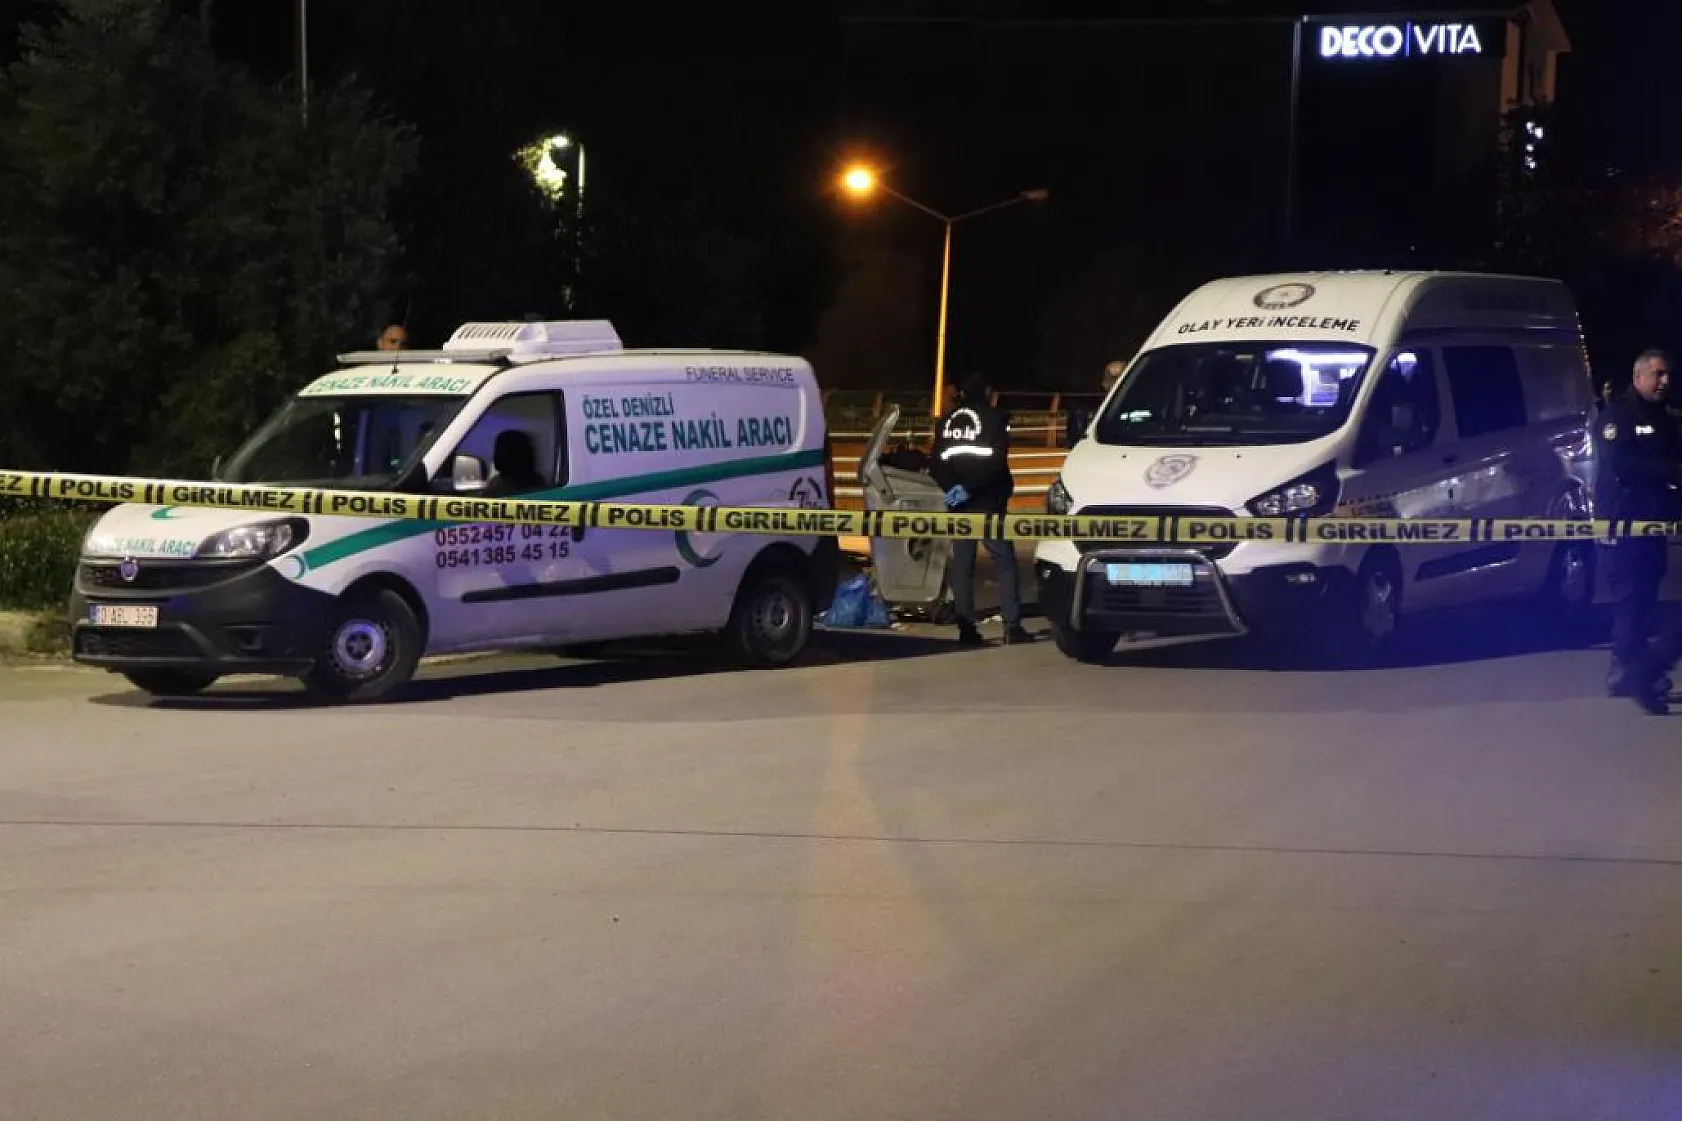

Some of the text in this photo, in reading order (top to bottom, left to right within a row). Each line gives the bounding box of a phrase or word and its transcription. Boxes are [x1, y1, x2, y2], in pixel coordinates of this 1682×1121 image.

[1321, 24, 1481, 56] DECO VITA
[1178, 319, 1223, 334] OLAY
[685, 366, 794, 382] FUNERAL SERVICE
[582, 394, 619, 418] ÖZEL
[584, 410, 793, 454] CENAZE NAKİL ARACI
[521, 543, 542, 561] 45
[548, 541, 569, 559] 15
